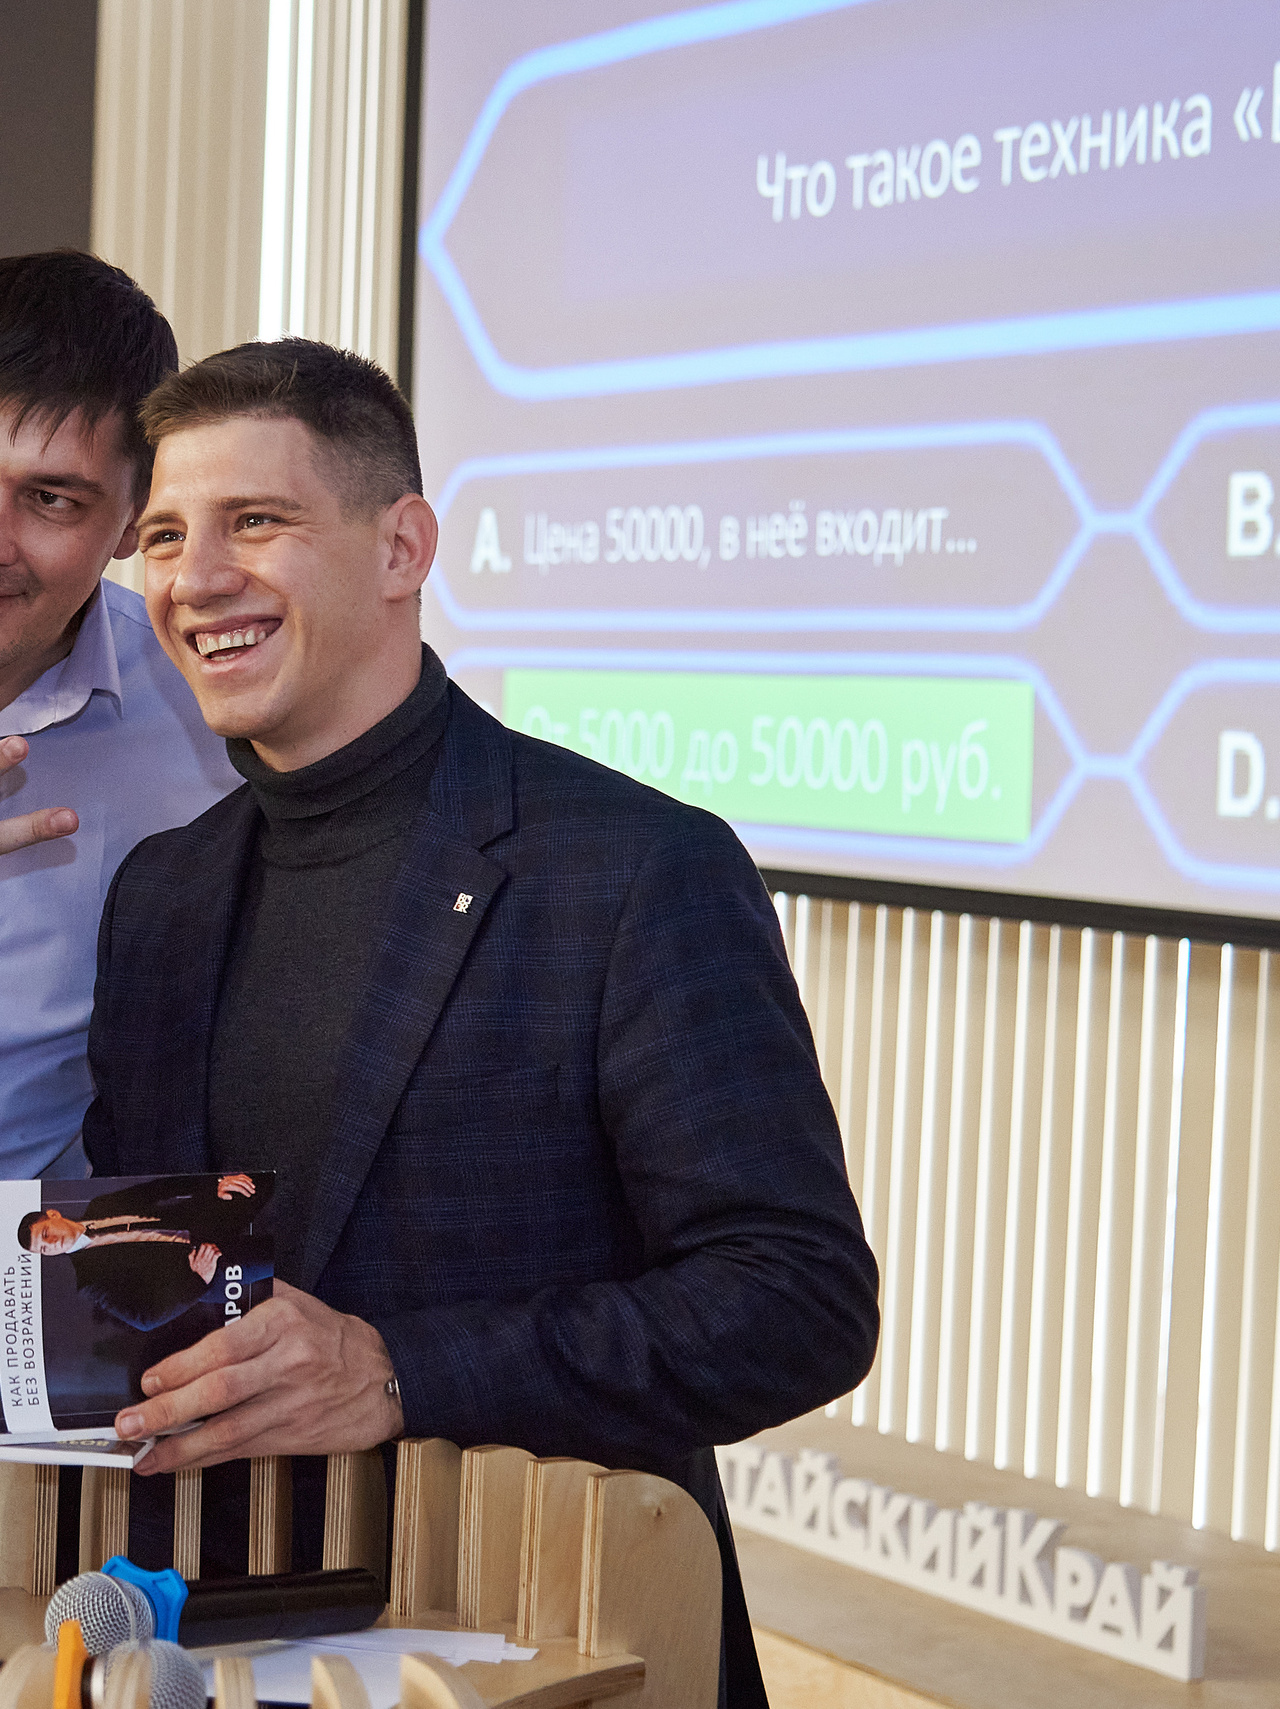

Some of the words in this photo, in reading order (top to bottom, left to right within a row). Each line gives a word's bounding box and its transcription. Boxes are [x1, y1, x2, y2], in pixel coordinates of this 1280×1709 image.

[756, 151, 837, 223] Что
[845, 133, 982, 211] такое
[993, 93, 1213, 187] техника
[523, 510, 601, 575] Цена
[604, 504, 712, 572] 50000,
[719, 515, 741, 561] в
[745, 500, 809, 559] неё
[579, 708, 675, 780] 5000
[680, 728, 739, 796] до
[748, 715, 889, 794] 50000
[901, 718, 1003, 814] руб.
[3, 1265, 20, 1369] ПРОДАВАТЬ
[17, 1252, 36, 1371] ВОЗРАЖЕНИЙ
[9, 1374, 23, 1408] КАК
[24, 1376, 40, 1406] БЕЗ
